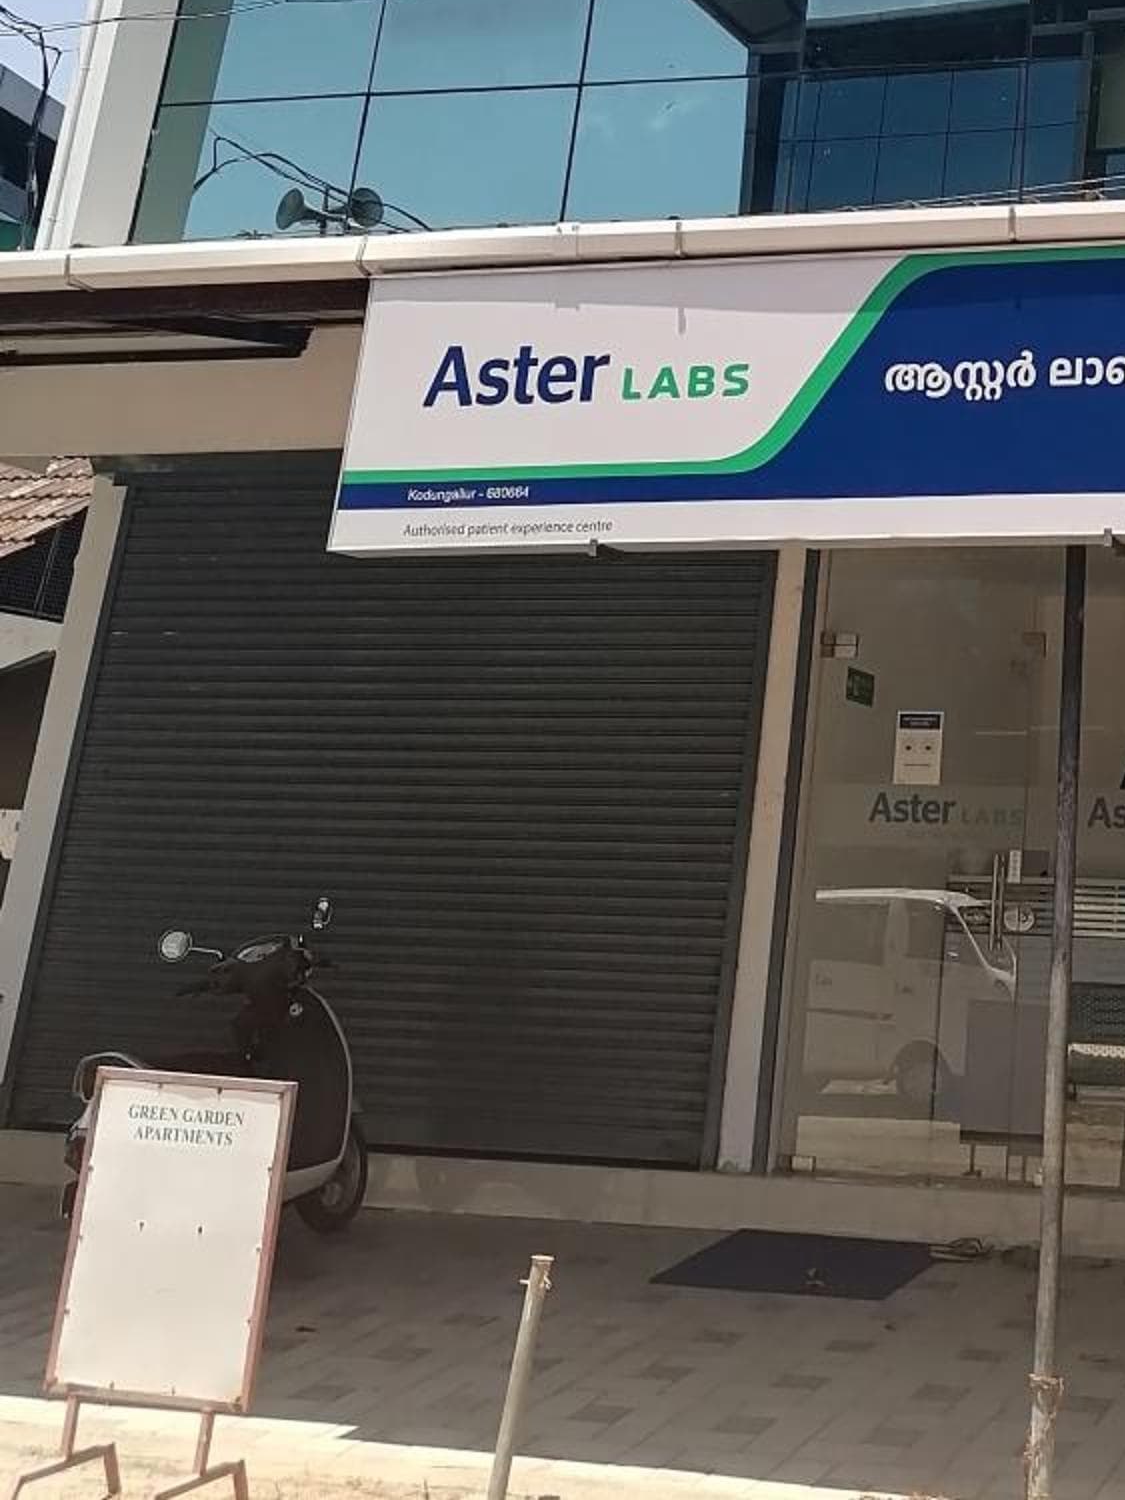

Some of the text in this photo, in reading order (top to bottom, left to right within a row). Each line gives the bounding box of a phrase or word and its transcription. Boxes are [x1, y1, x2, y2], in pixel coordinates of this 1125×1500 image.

[423, 346, 750, 407] Aster LABS
[403, 520, 613, 538] Authorised patient experience centre
[868, 791, 956, 825] Aster
[128, 1103, 245, 1127] GREEN GARDEN
[133, 1126, 233, 1146] APARTMENTS
